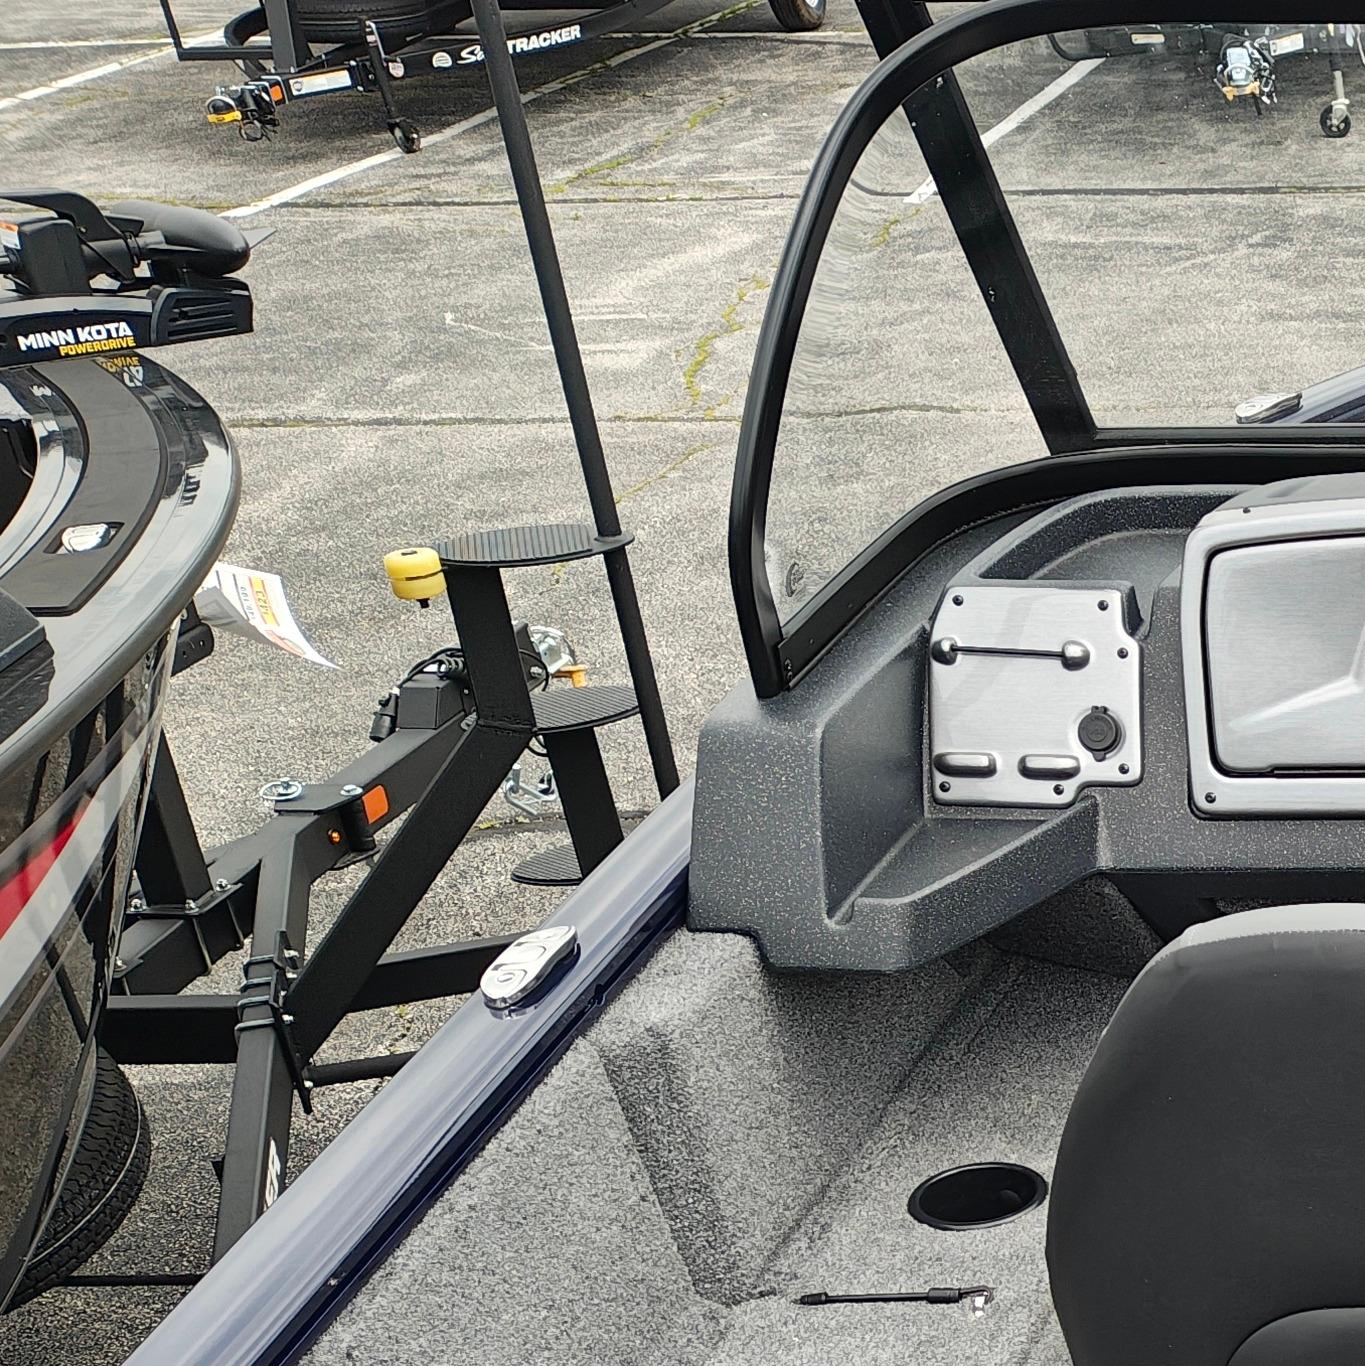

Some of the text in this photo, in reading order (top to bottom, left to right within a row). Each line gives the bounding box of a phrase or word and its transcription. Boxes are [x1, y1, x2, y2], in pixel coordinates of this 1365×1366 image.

[507, 24, 581, 54] TRACKER
[16, 321, 134, 352] MINN KOTA
[59, 336, 136, 357] POWERDRIVE
